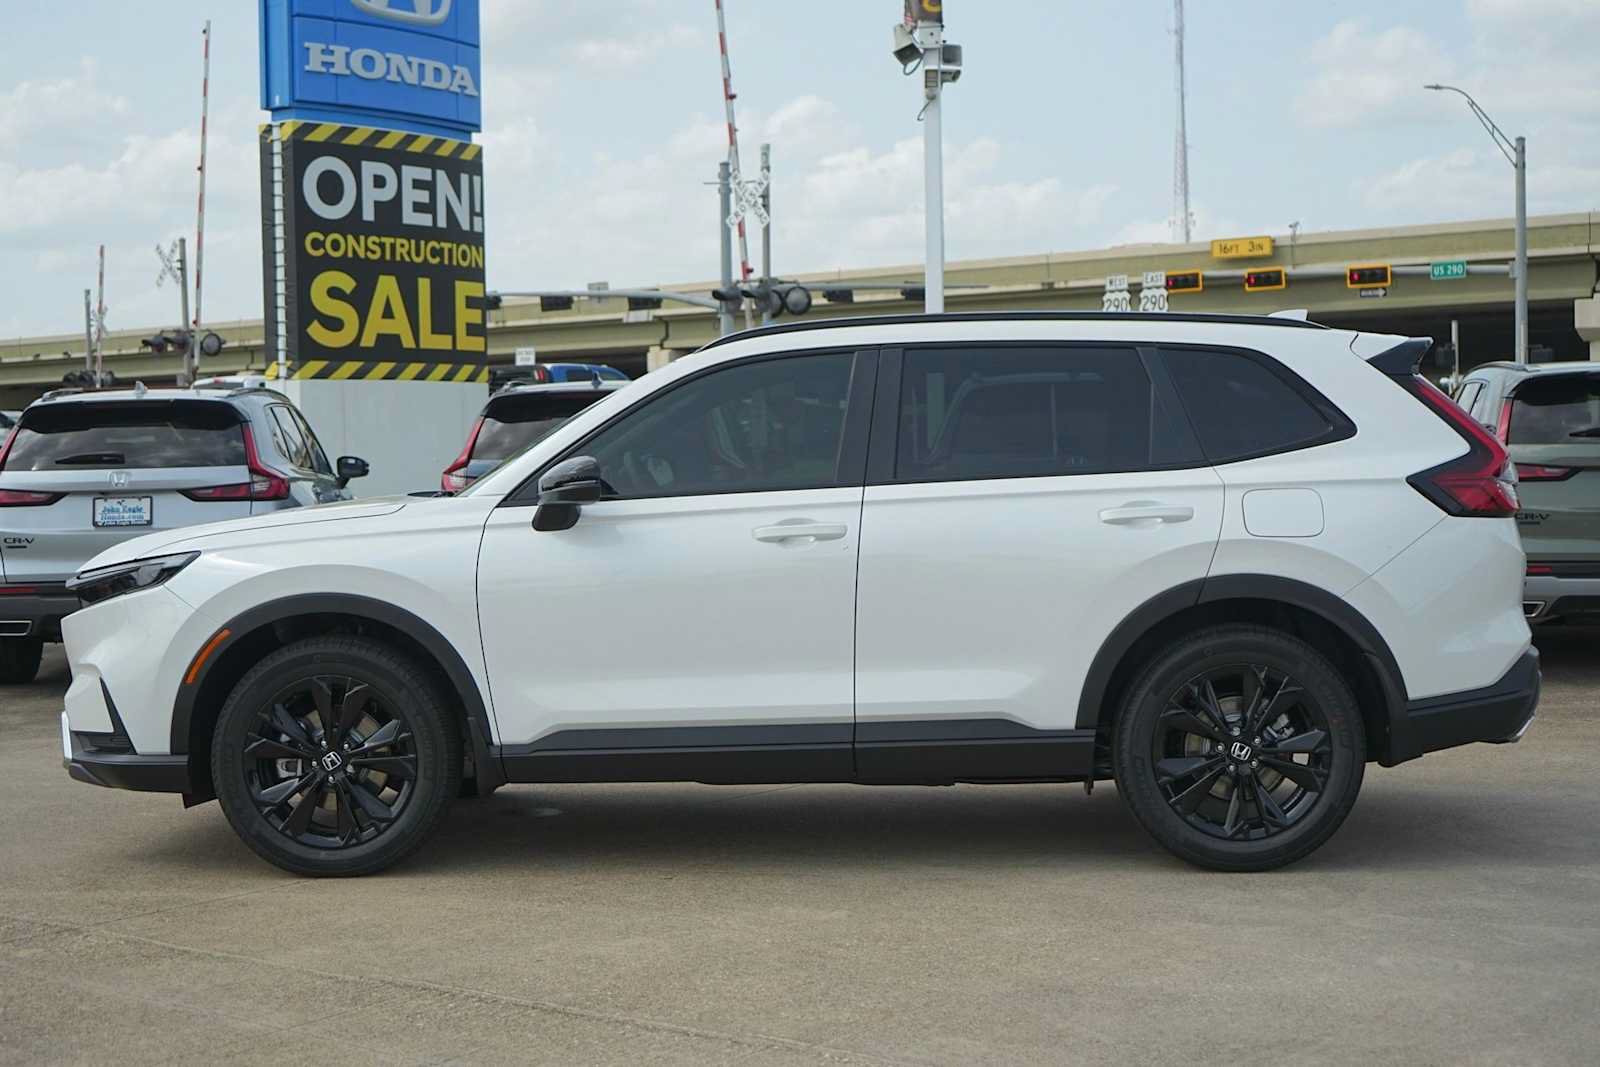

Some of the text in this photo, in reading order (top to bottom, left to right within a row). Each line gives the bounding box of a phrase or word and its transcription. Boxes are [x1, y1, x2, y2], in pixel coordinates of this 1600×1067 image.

[304, 41, 479, 97] HONDA
[302, 155, 483, 233] OPEN!
[304, 231, 484, 269] CONSTRUCTION
[1433, 263, 1464, 276] US 290
[1108, 277, 1126, 287] WEST
[1144, 273, 1164, 284] EAST
[306, 270, 486, 352] SALE
[1105, 297, 1128, 312] 290
[1142, 294, 1166, 311] 290
